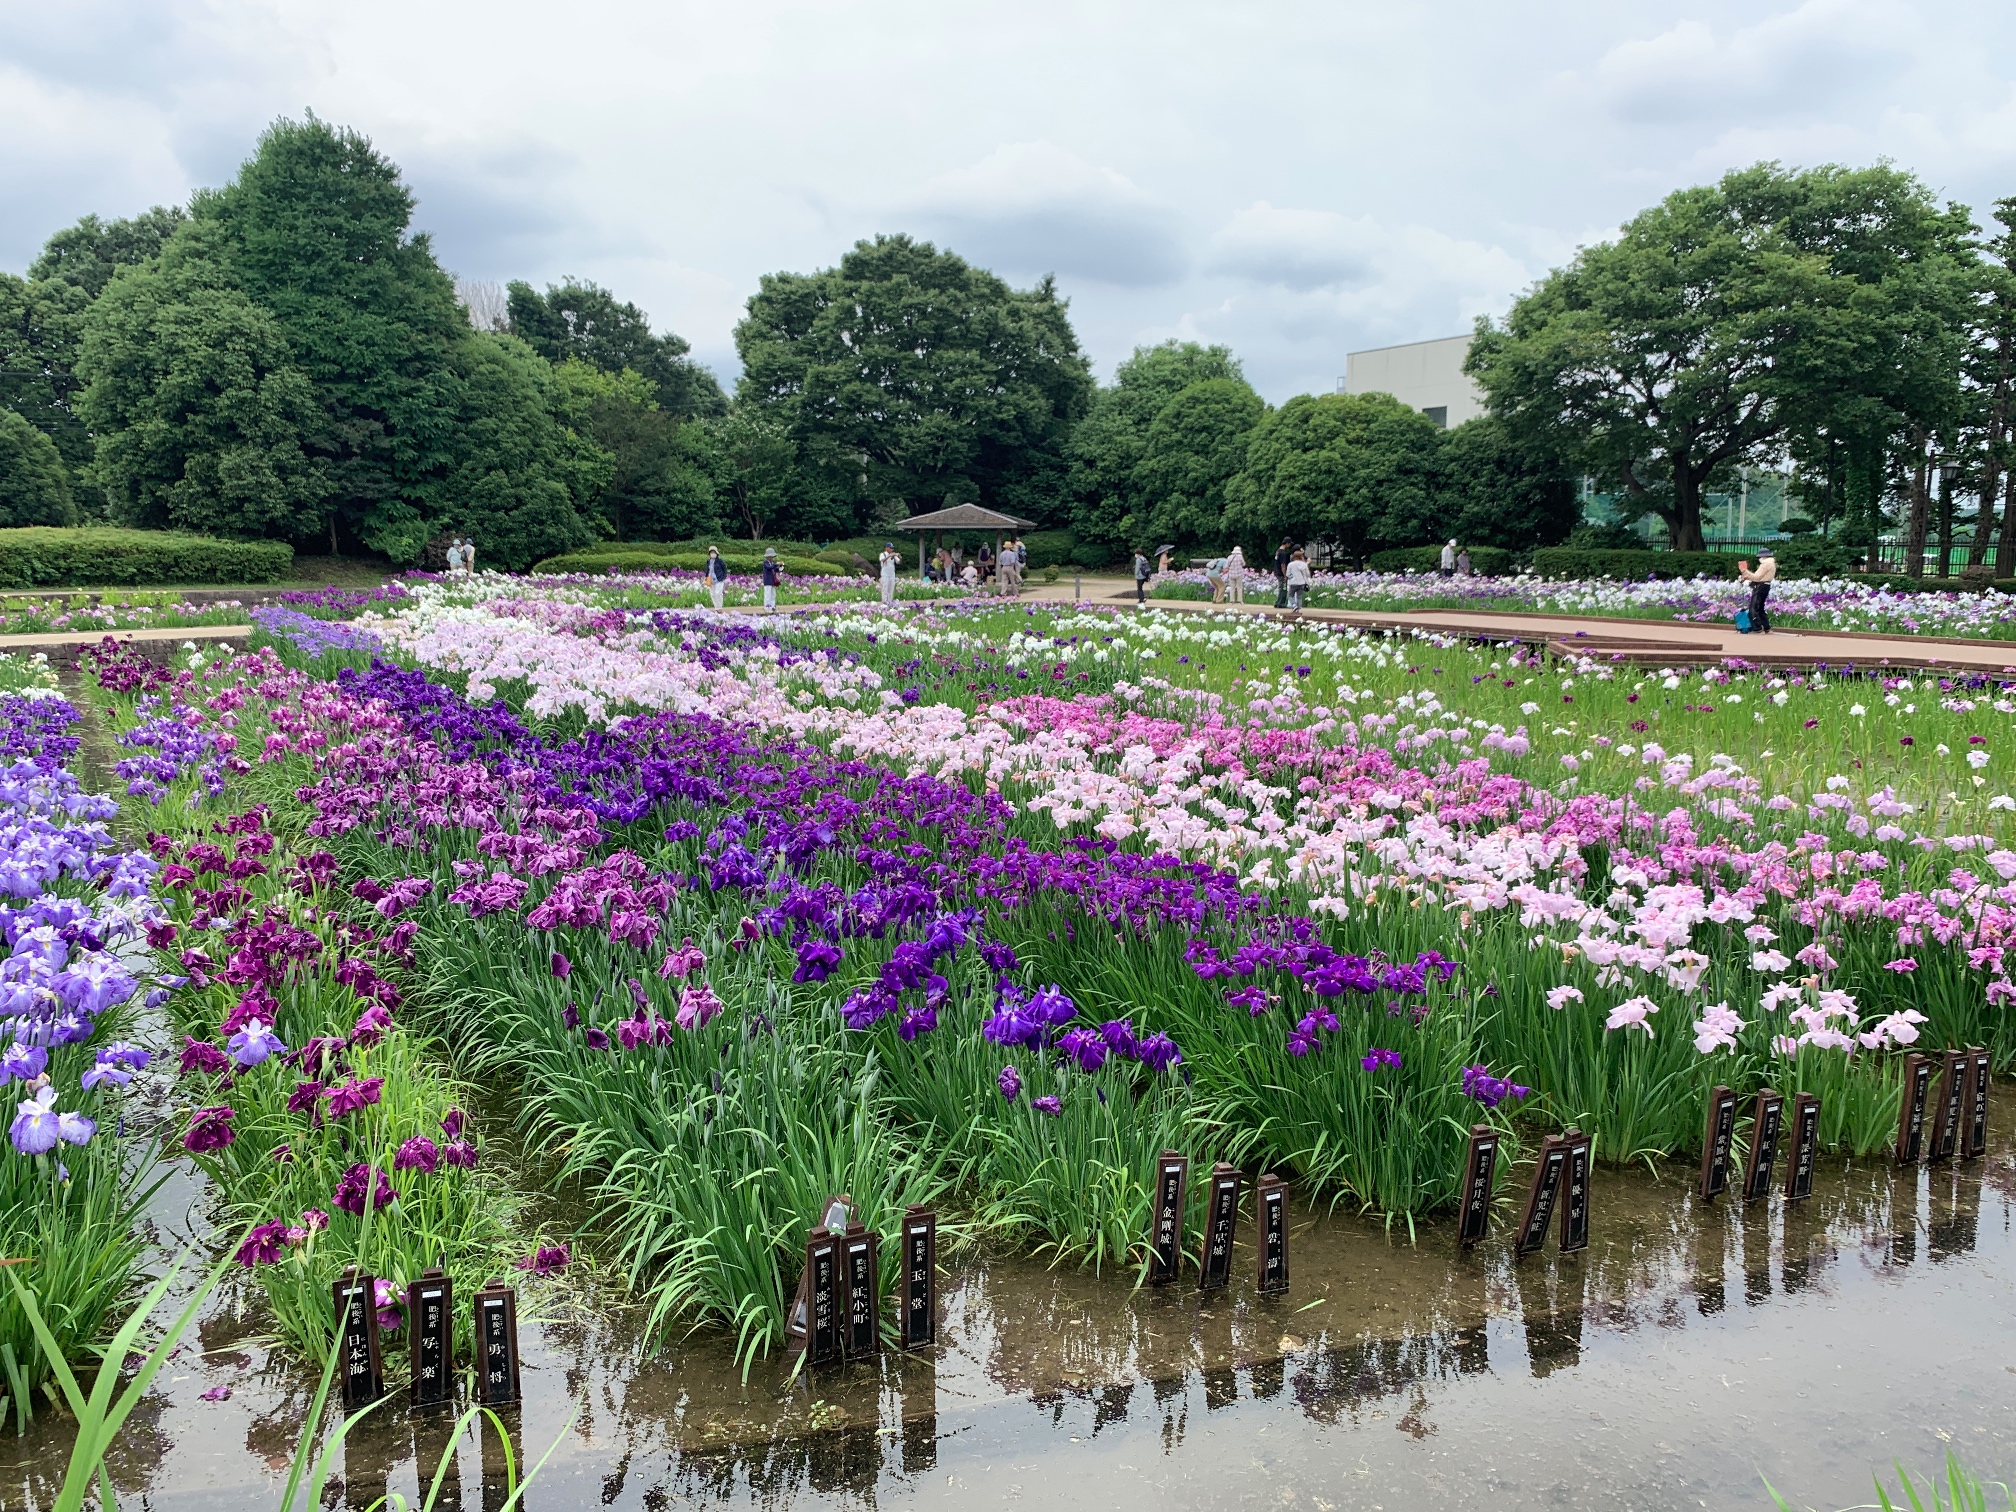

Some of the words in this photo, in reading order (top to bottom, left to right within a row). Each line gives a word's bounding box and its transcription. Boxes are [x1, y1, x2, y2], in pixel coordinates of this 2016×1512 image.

[1471, 1177, 1485, 1211] 桜月夜
[1159, 1206, 1172, 1245] 金剛城
[1213, 1219, 1226, 1256] 千早城
[852, 1286, 865, 1325] 紅小町
[911, 1269, 923, 1311] 玉堂
[350, 1303, 360, 1325] 肥後系
[428, 1305, 437, 1329] 肥後系
[491, 1313, 501, 1336] 肥後系
[816, 1290, 828, 1330] 淡雪桜
[348, 1333, 364, 1376] 日本海
[422, 1337, 435, 1379] 写楽
[488, 1343, 502, 1384] 勇将
